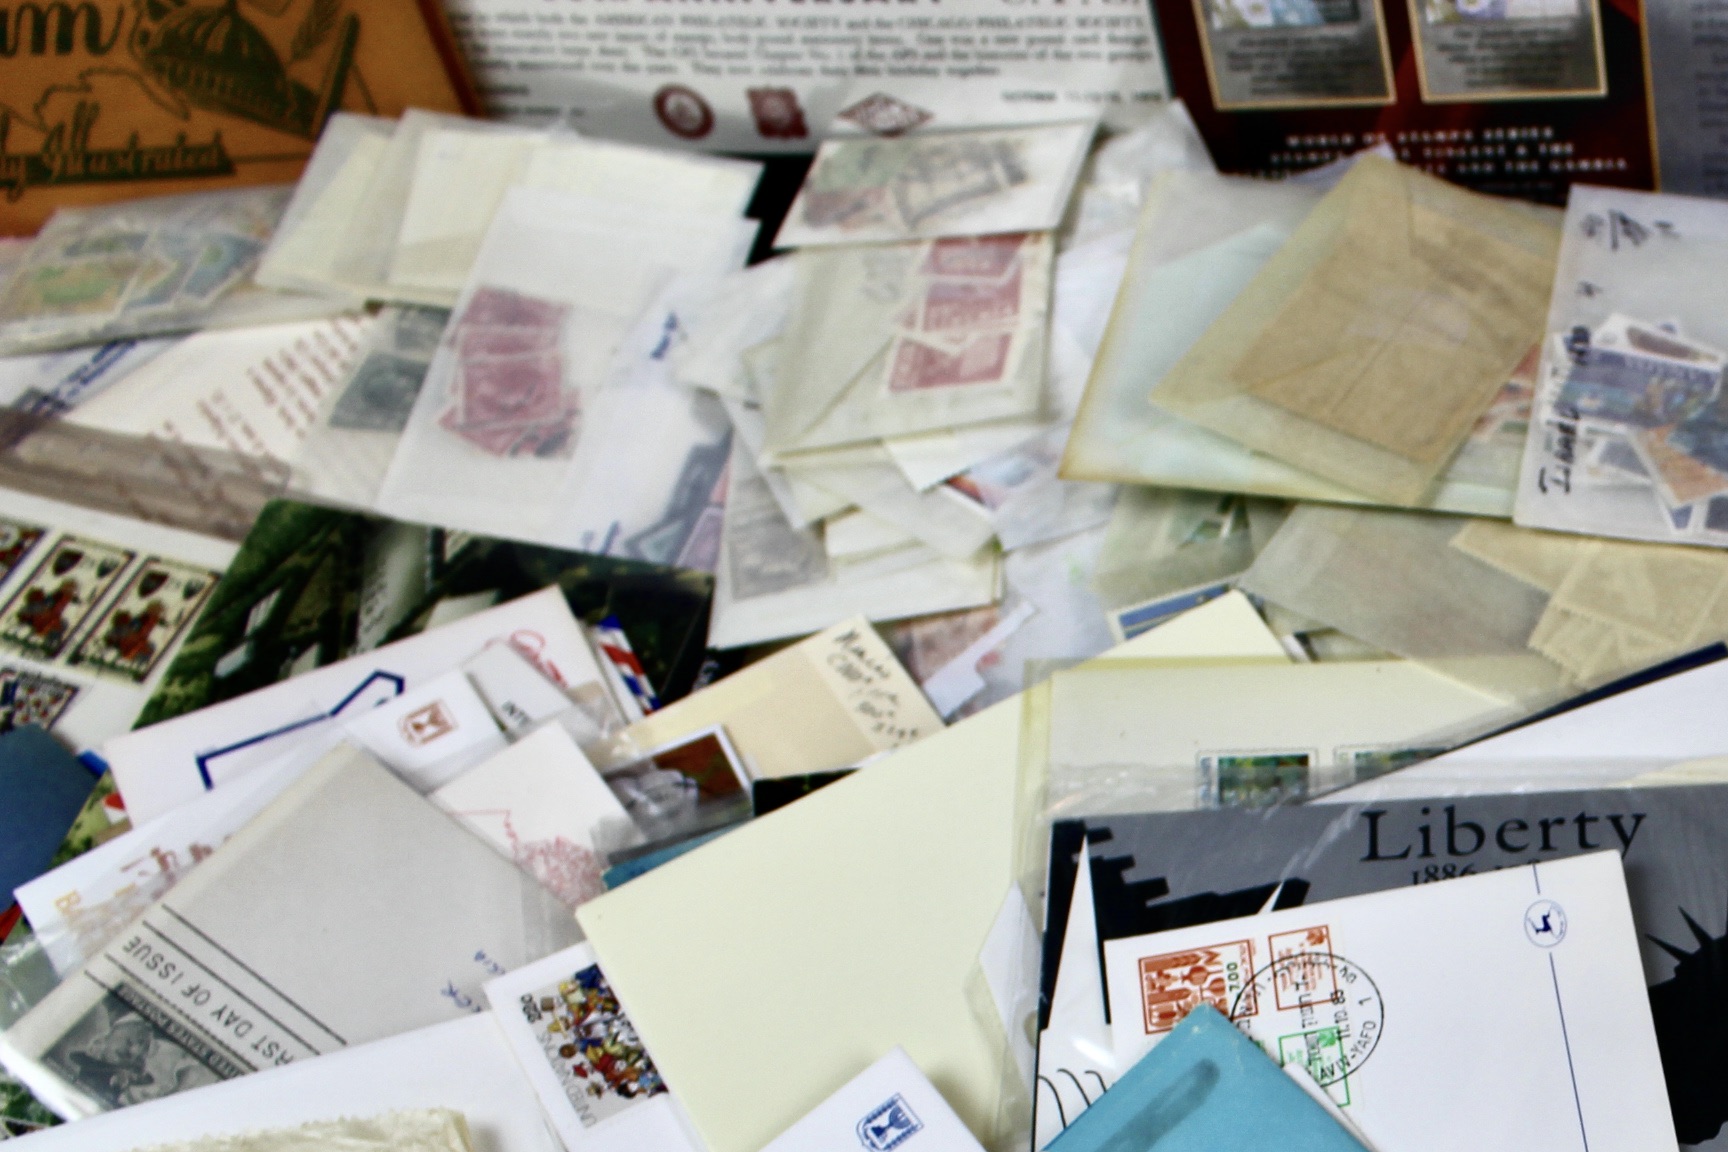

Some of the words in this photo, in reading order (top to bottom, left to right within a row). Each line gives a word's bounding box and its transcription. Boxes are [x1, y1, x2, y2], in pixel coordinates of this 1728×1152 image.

[1360, 805, 1646, 863] Liberty
[123, 936, 183, 983] ISSUE
[180, 983, 211, 1006] OF
[211, 1004, 252, 1037] DAY
[250, 1035, 293, 1066] RST
